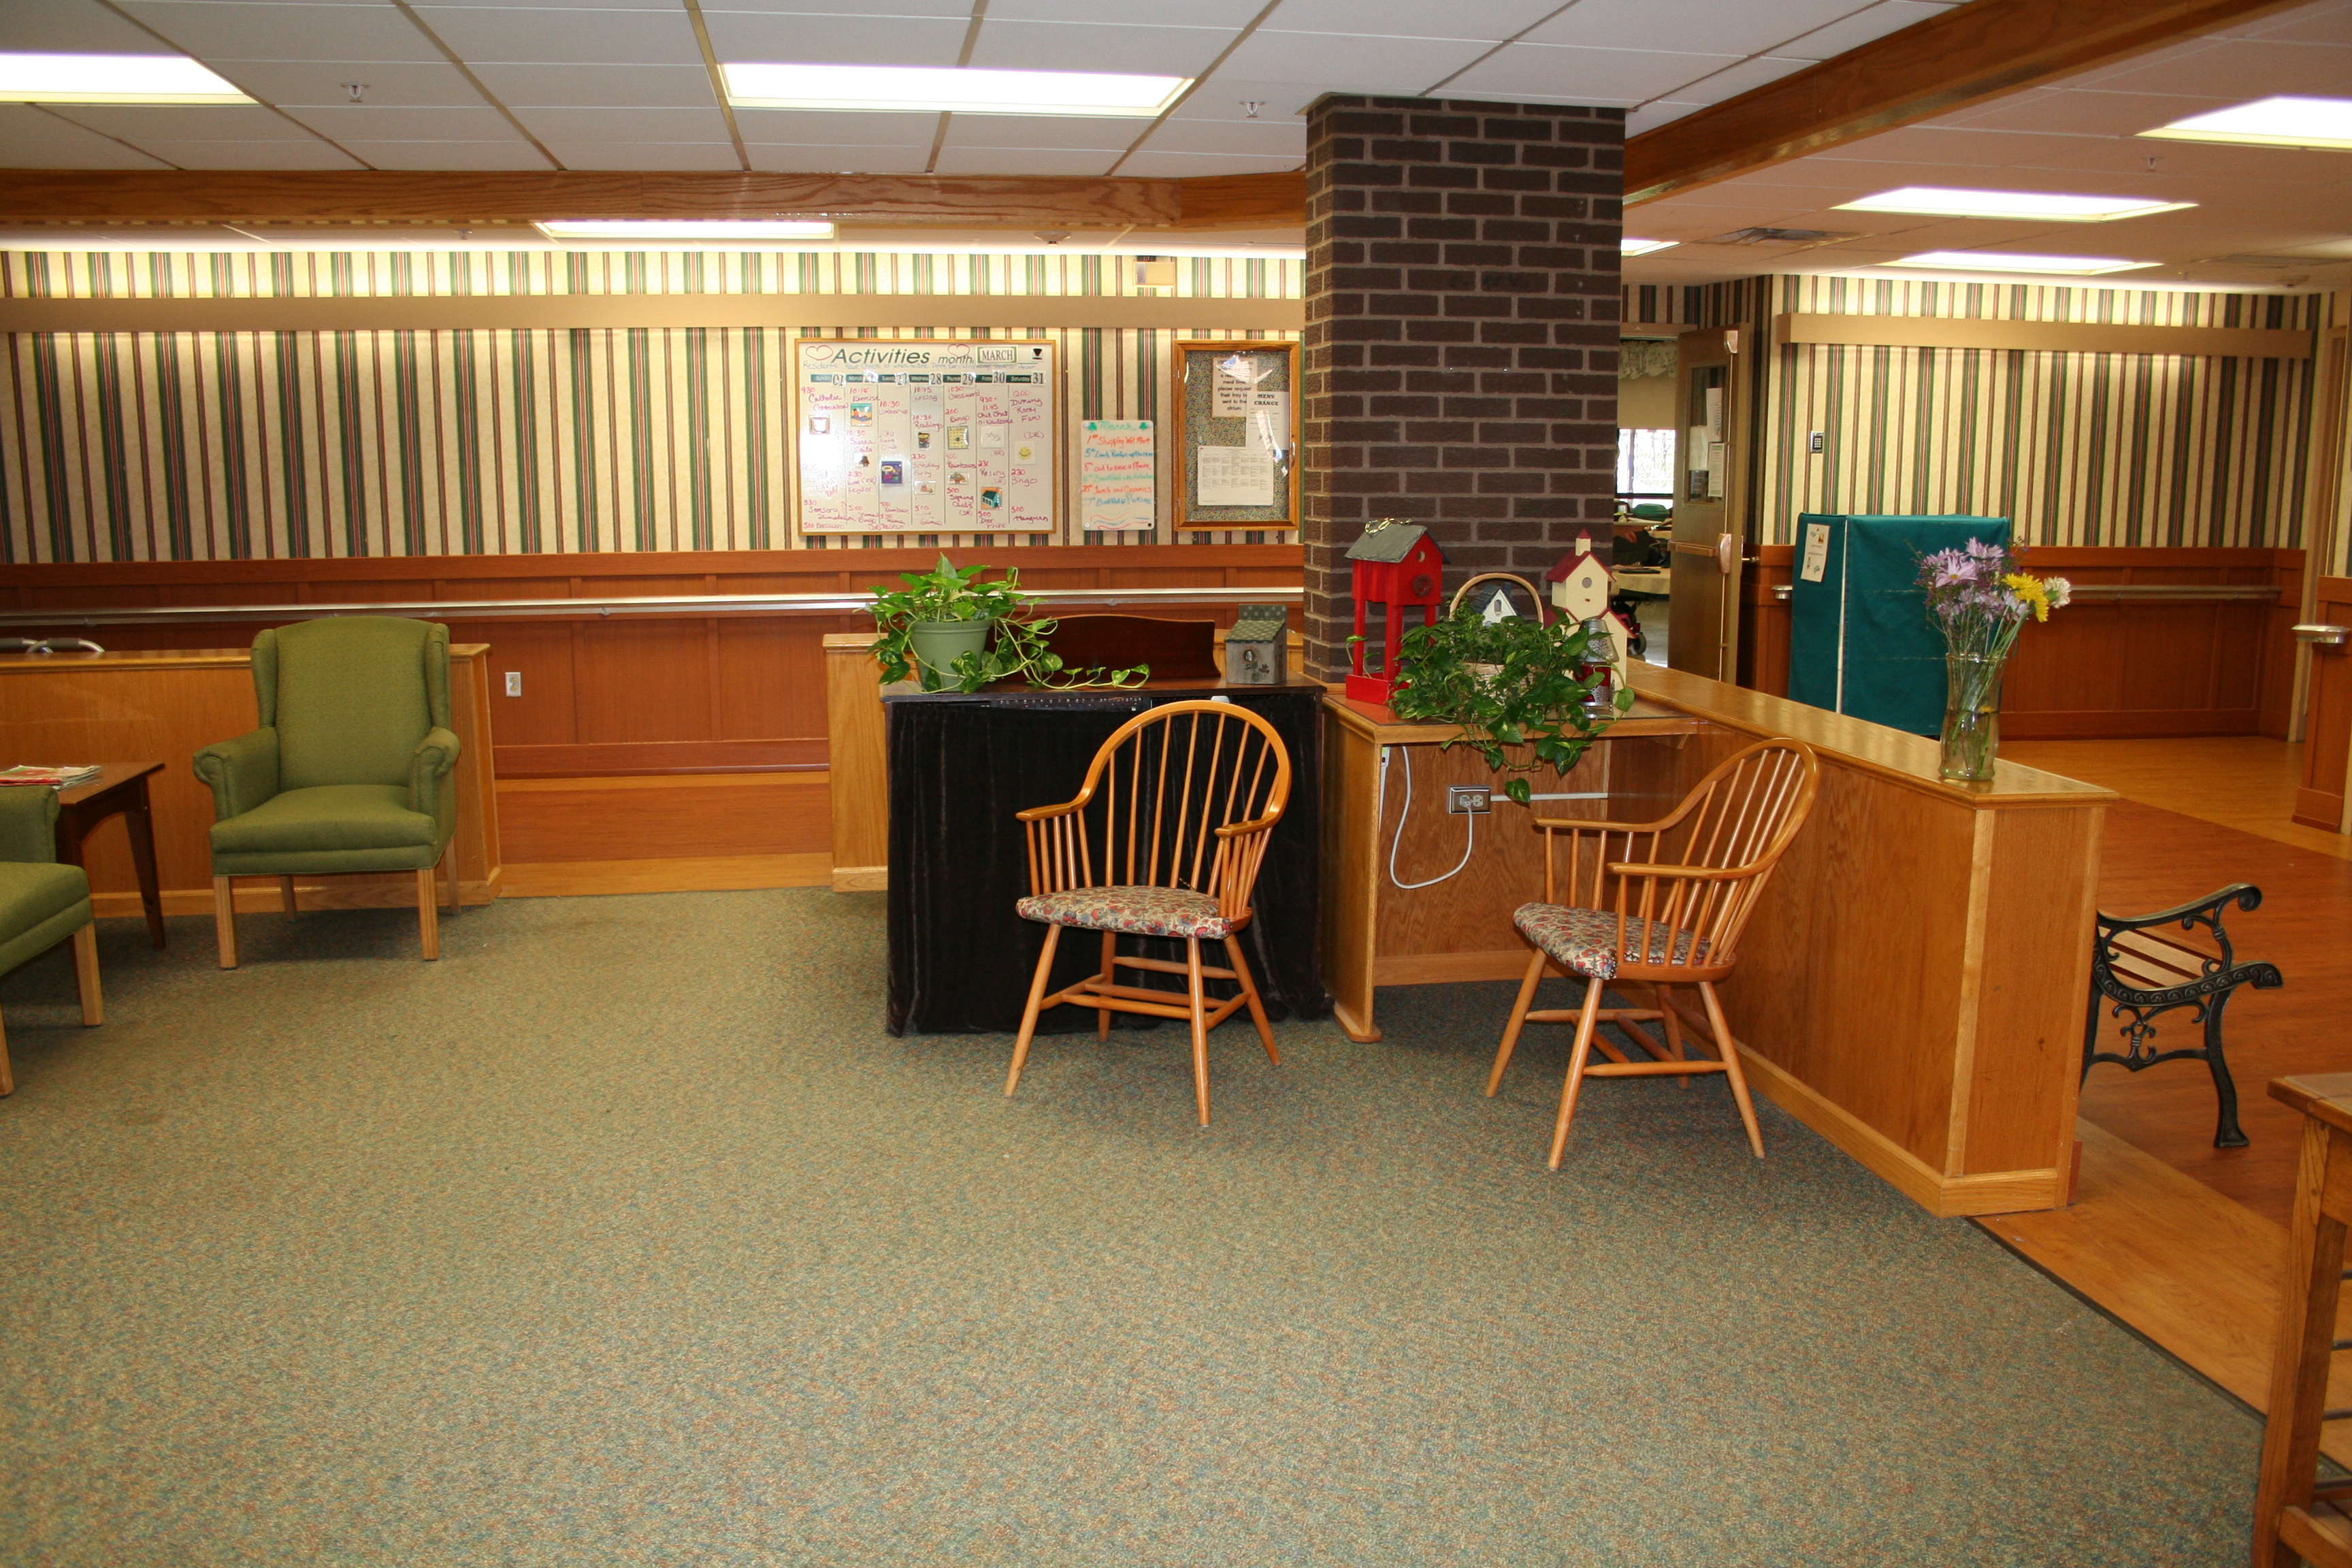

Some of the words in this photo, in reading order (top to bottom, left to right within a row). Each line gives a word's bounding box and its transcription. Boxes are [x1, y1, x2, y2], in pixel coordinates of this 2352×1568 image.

[831, 348, 931, 365] Activities
[981, 350, 1013, 361] MARCH
[930, 373, 942, 385] 28
[962, 373, 974, 385] 29
[993, 372, 1005, 384] 30
[1032, 372, 1044, 385] 31
[808, 393, 843, 404] Catholic
[1011, 476, 1039, 487] Bingo
